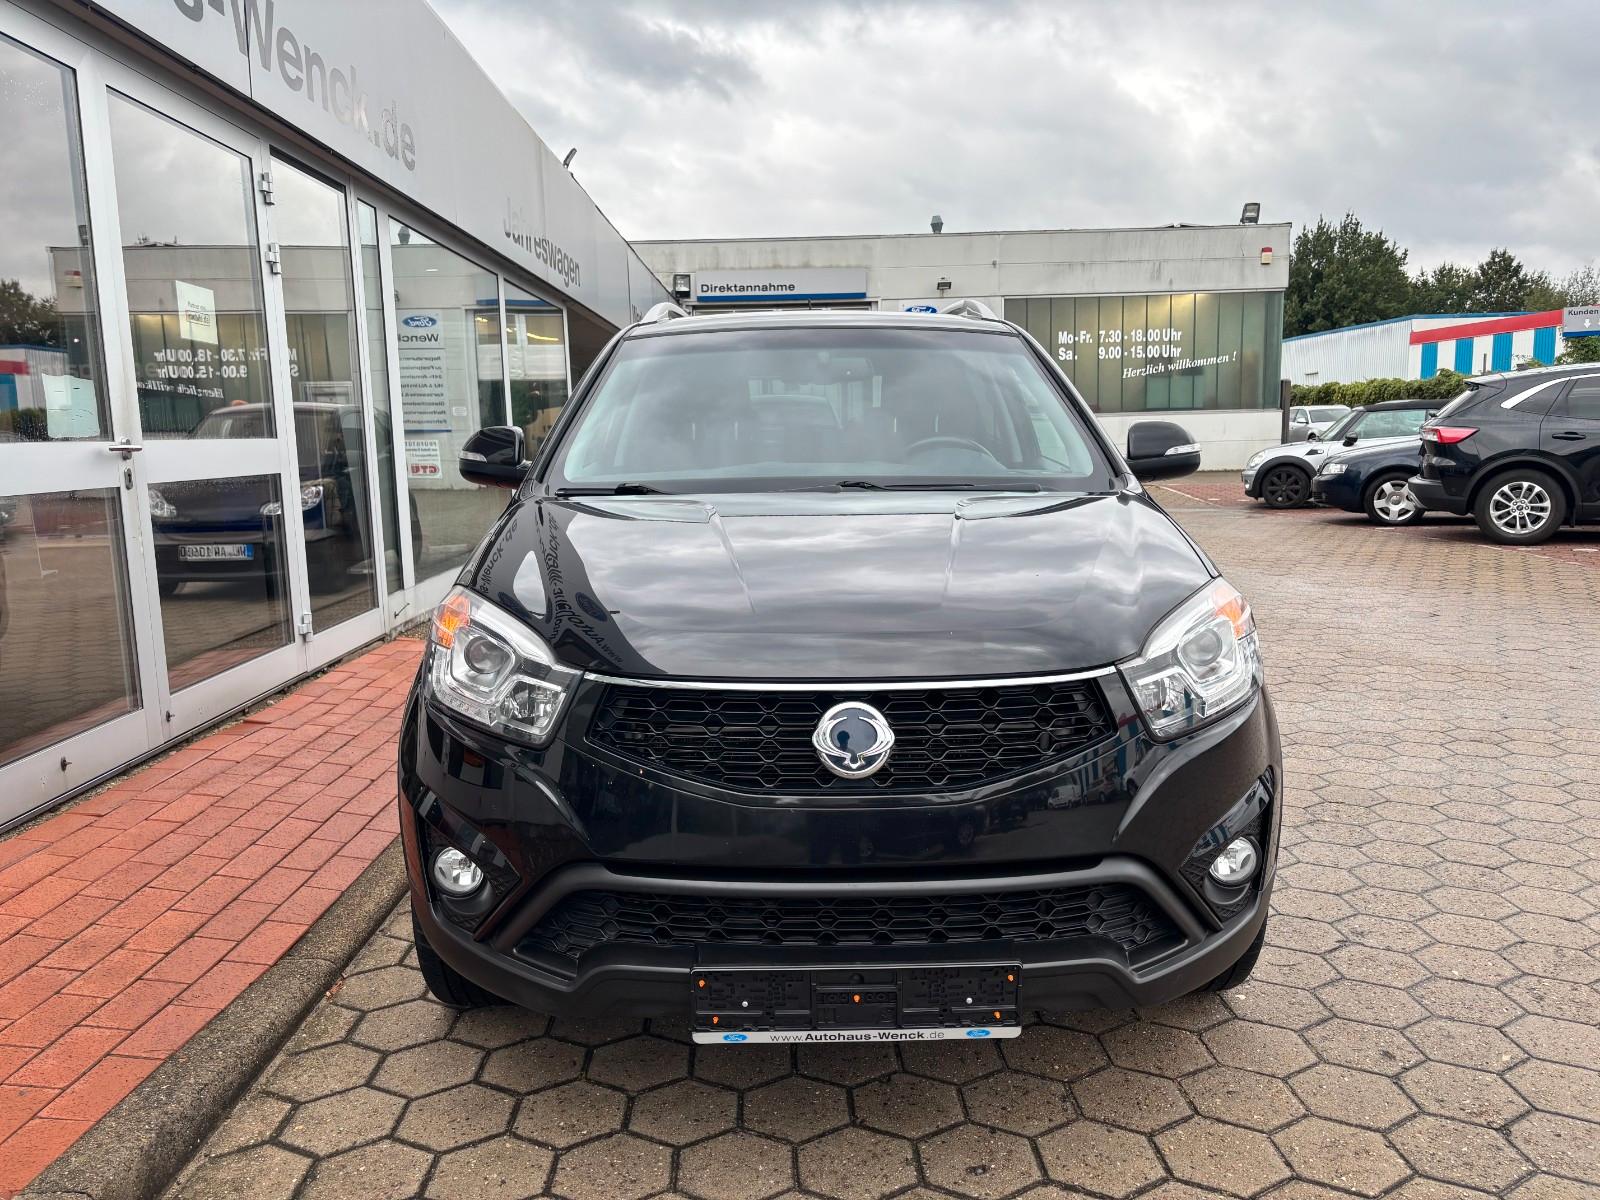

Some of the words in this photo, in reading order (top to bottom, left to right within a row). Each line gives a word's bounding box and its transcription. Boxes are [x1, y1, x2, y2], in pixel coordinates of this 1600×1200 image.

[503, 197, 581, 288] Jahreswagen
[700, 282, 796, 293] Direktannahme
[1099, 330, 1121, 343] 7.30
[1131, 329, 1160, 342] 18.00
[1162, 328, 1182, 341] Uhr
[1098, 346, 1121, 359] 9.00
[1131, 346, 1160, 359] 15.00
[1162, 345, 1182, 358] Uhr
[1122, 365, 1165, 379] Herzlich
[1167, 354, 1229, 371] willkommen
[769, 1031, 945, 1042] www.Autohaus-Wenck.de
